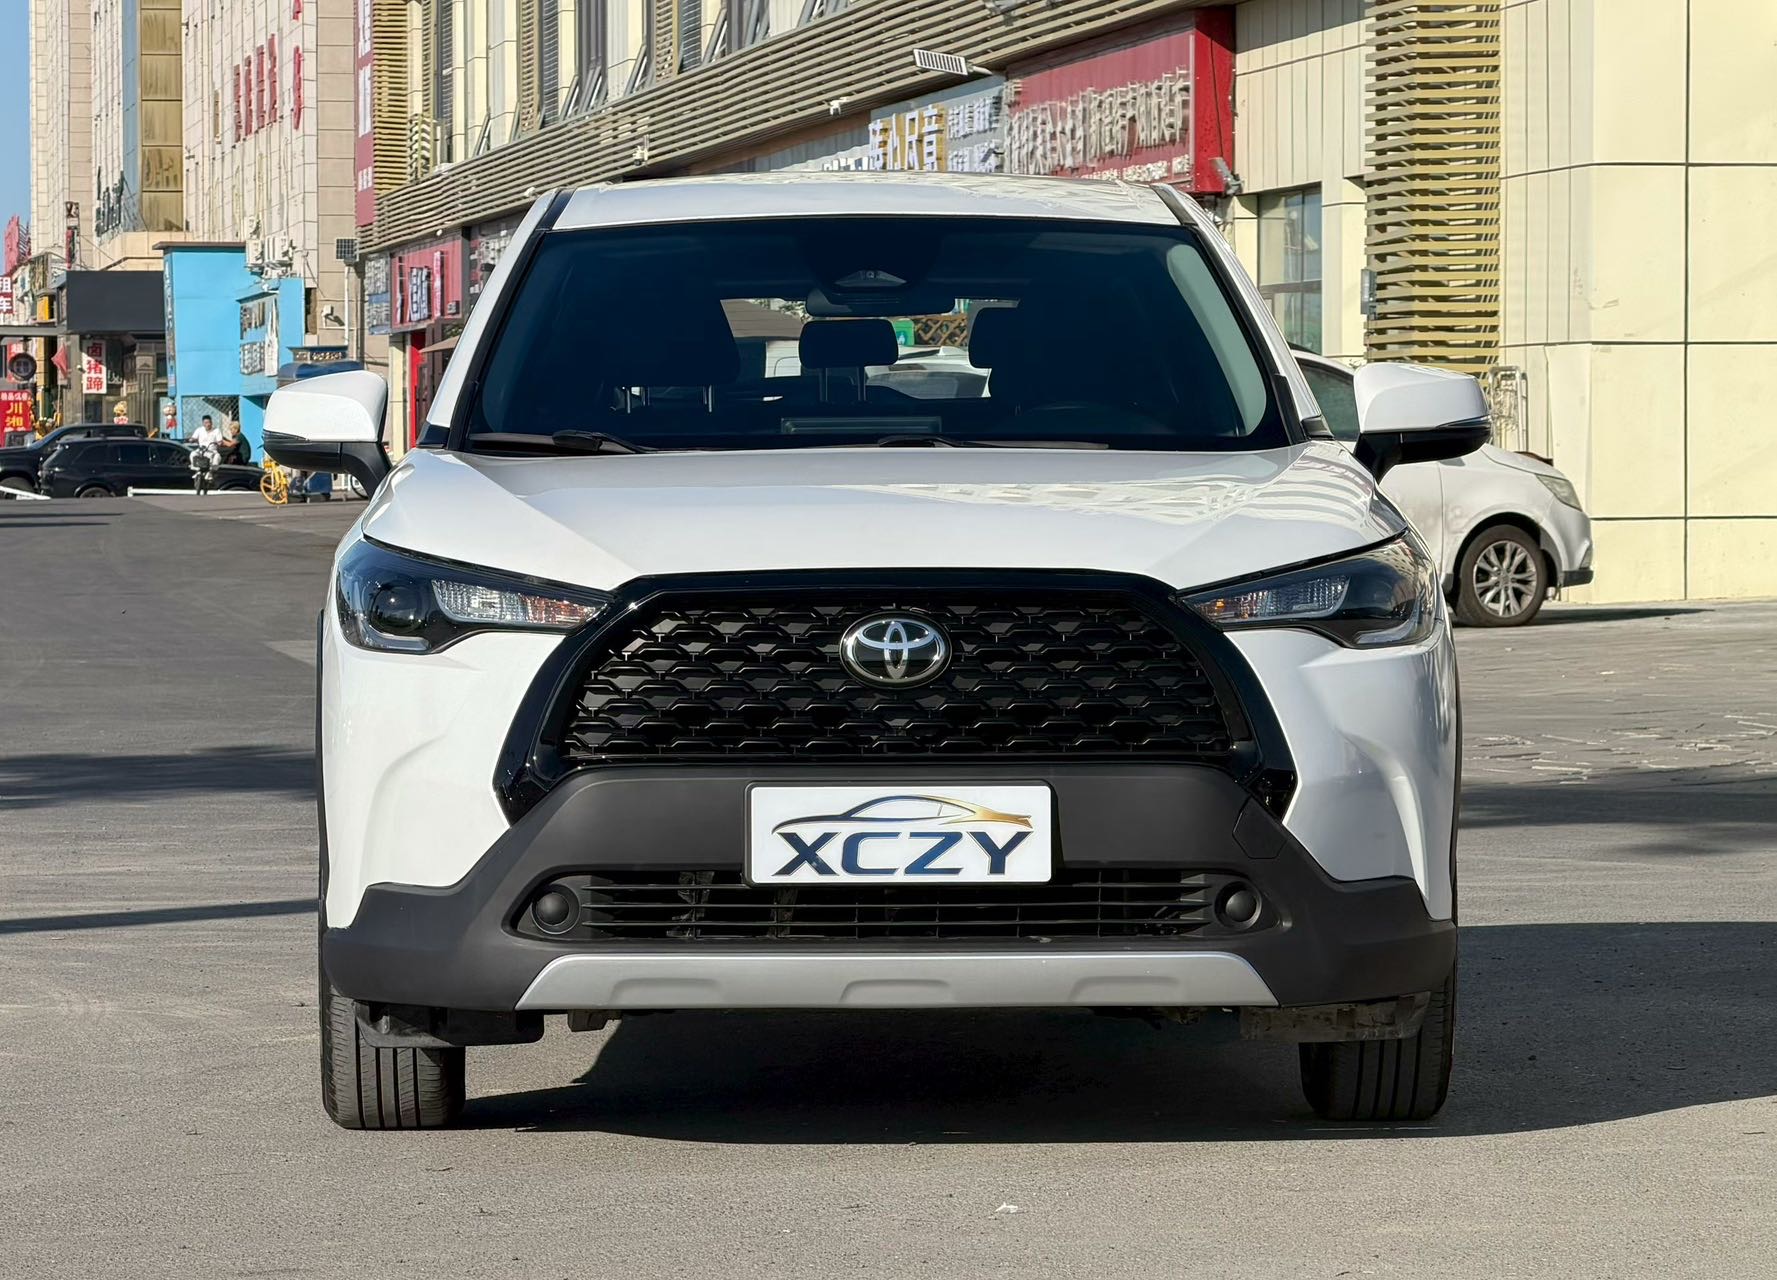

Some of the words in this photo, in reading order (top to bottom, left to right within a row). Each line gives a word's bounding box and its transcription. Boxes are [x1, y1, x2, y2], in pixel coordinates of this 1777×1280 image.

[86, 342, 103, 391] 卤猪蹄
[771, 831, 1035, 876] XCZY
